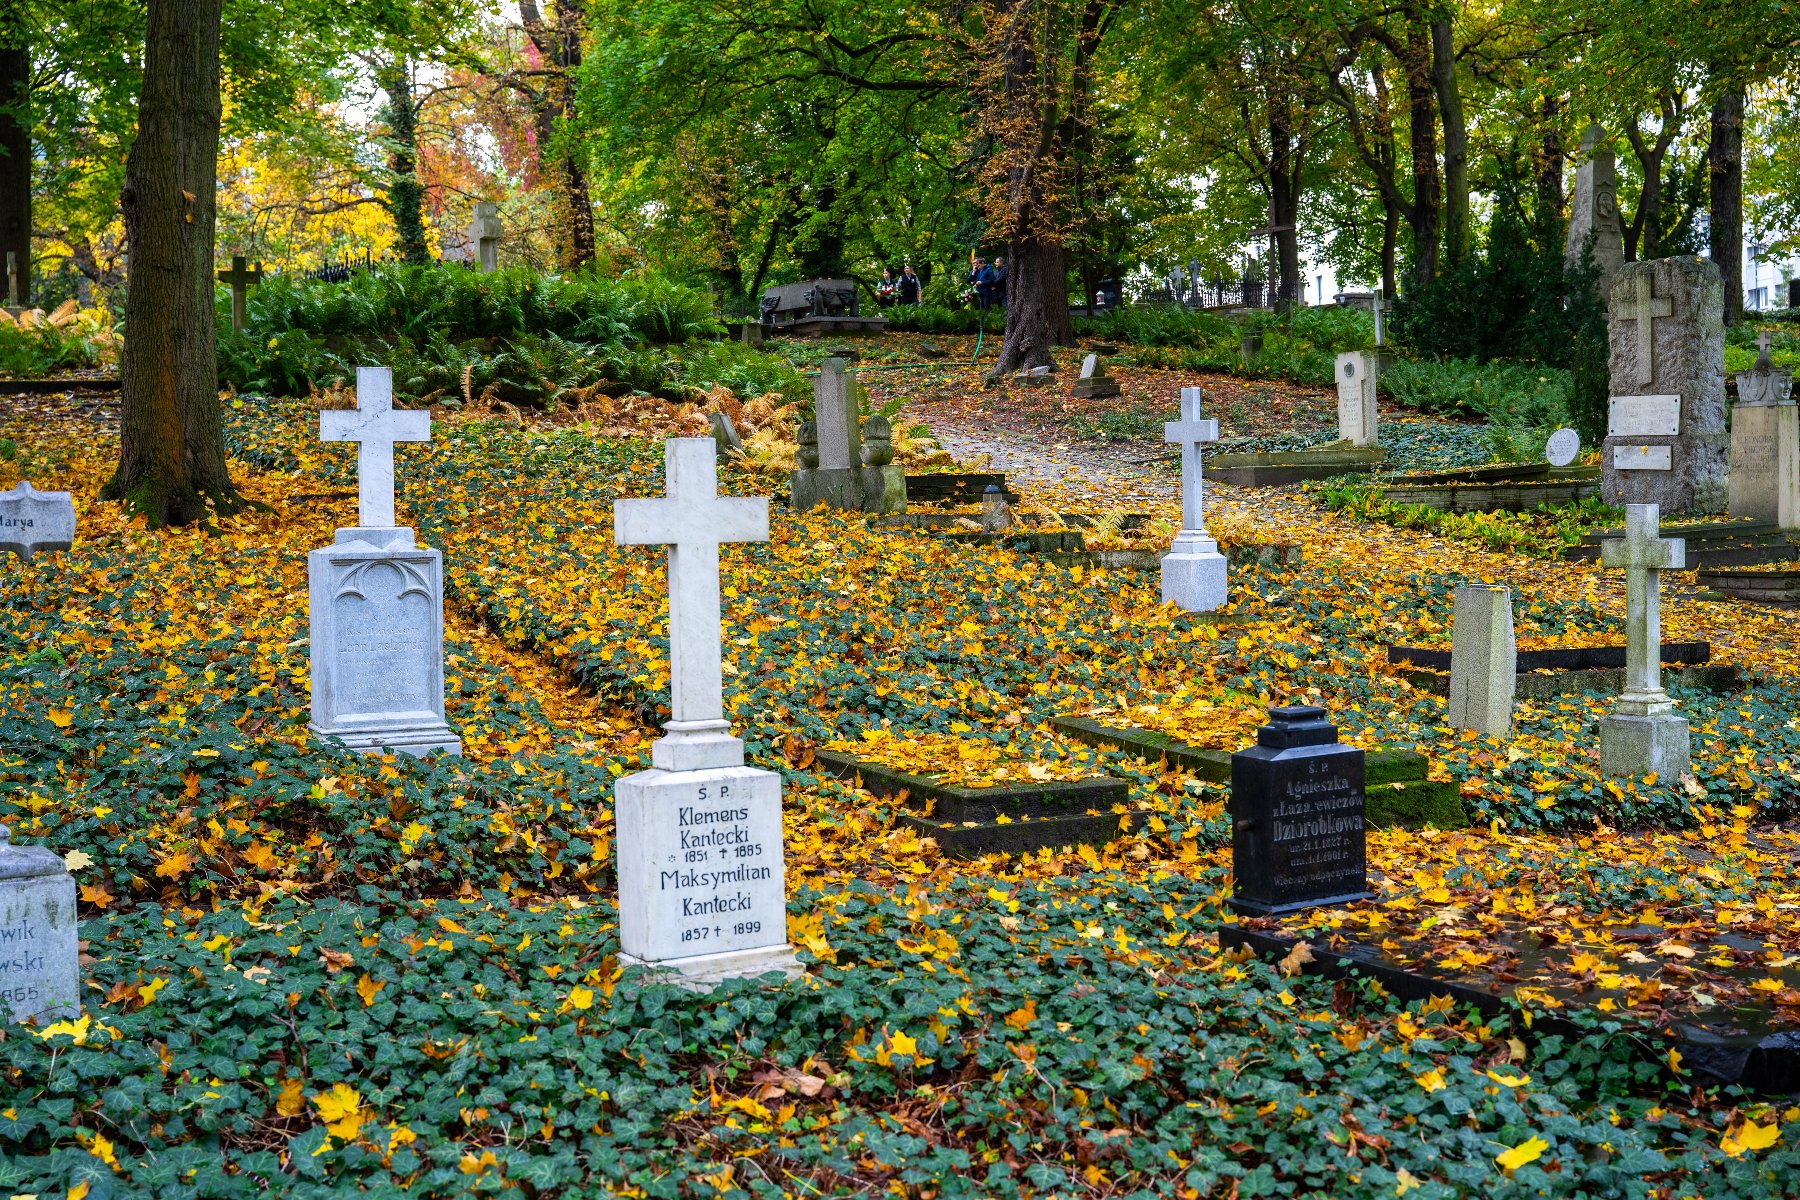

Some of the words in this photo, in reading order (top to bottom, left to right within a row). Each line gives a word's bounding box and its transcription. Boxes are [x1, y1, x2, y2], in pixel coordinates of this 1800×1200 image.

[720, 785, 729, 798] P.
[1286, 775, 1349, 801] Agnieszka
[679, 807, 749, 827] Klemens
[680, 825, 749, 849] Kantecki
[685, 850, 708, 863] 1851
[734, 844, 762, 858] 1885
[661, 864, 770, 890] Maksymilian
[683, 892, 751, 916] Kantecki
[682, 927, 709, 942] 1857
[733, 921, 761, 935] 1899
